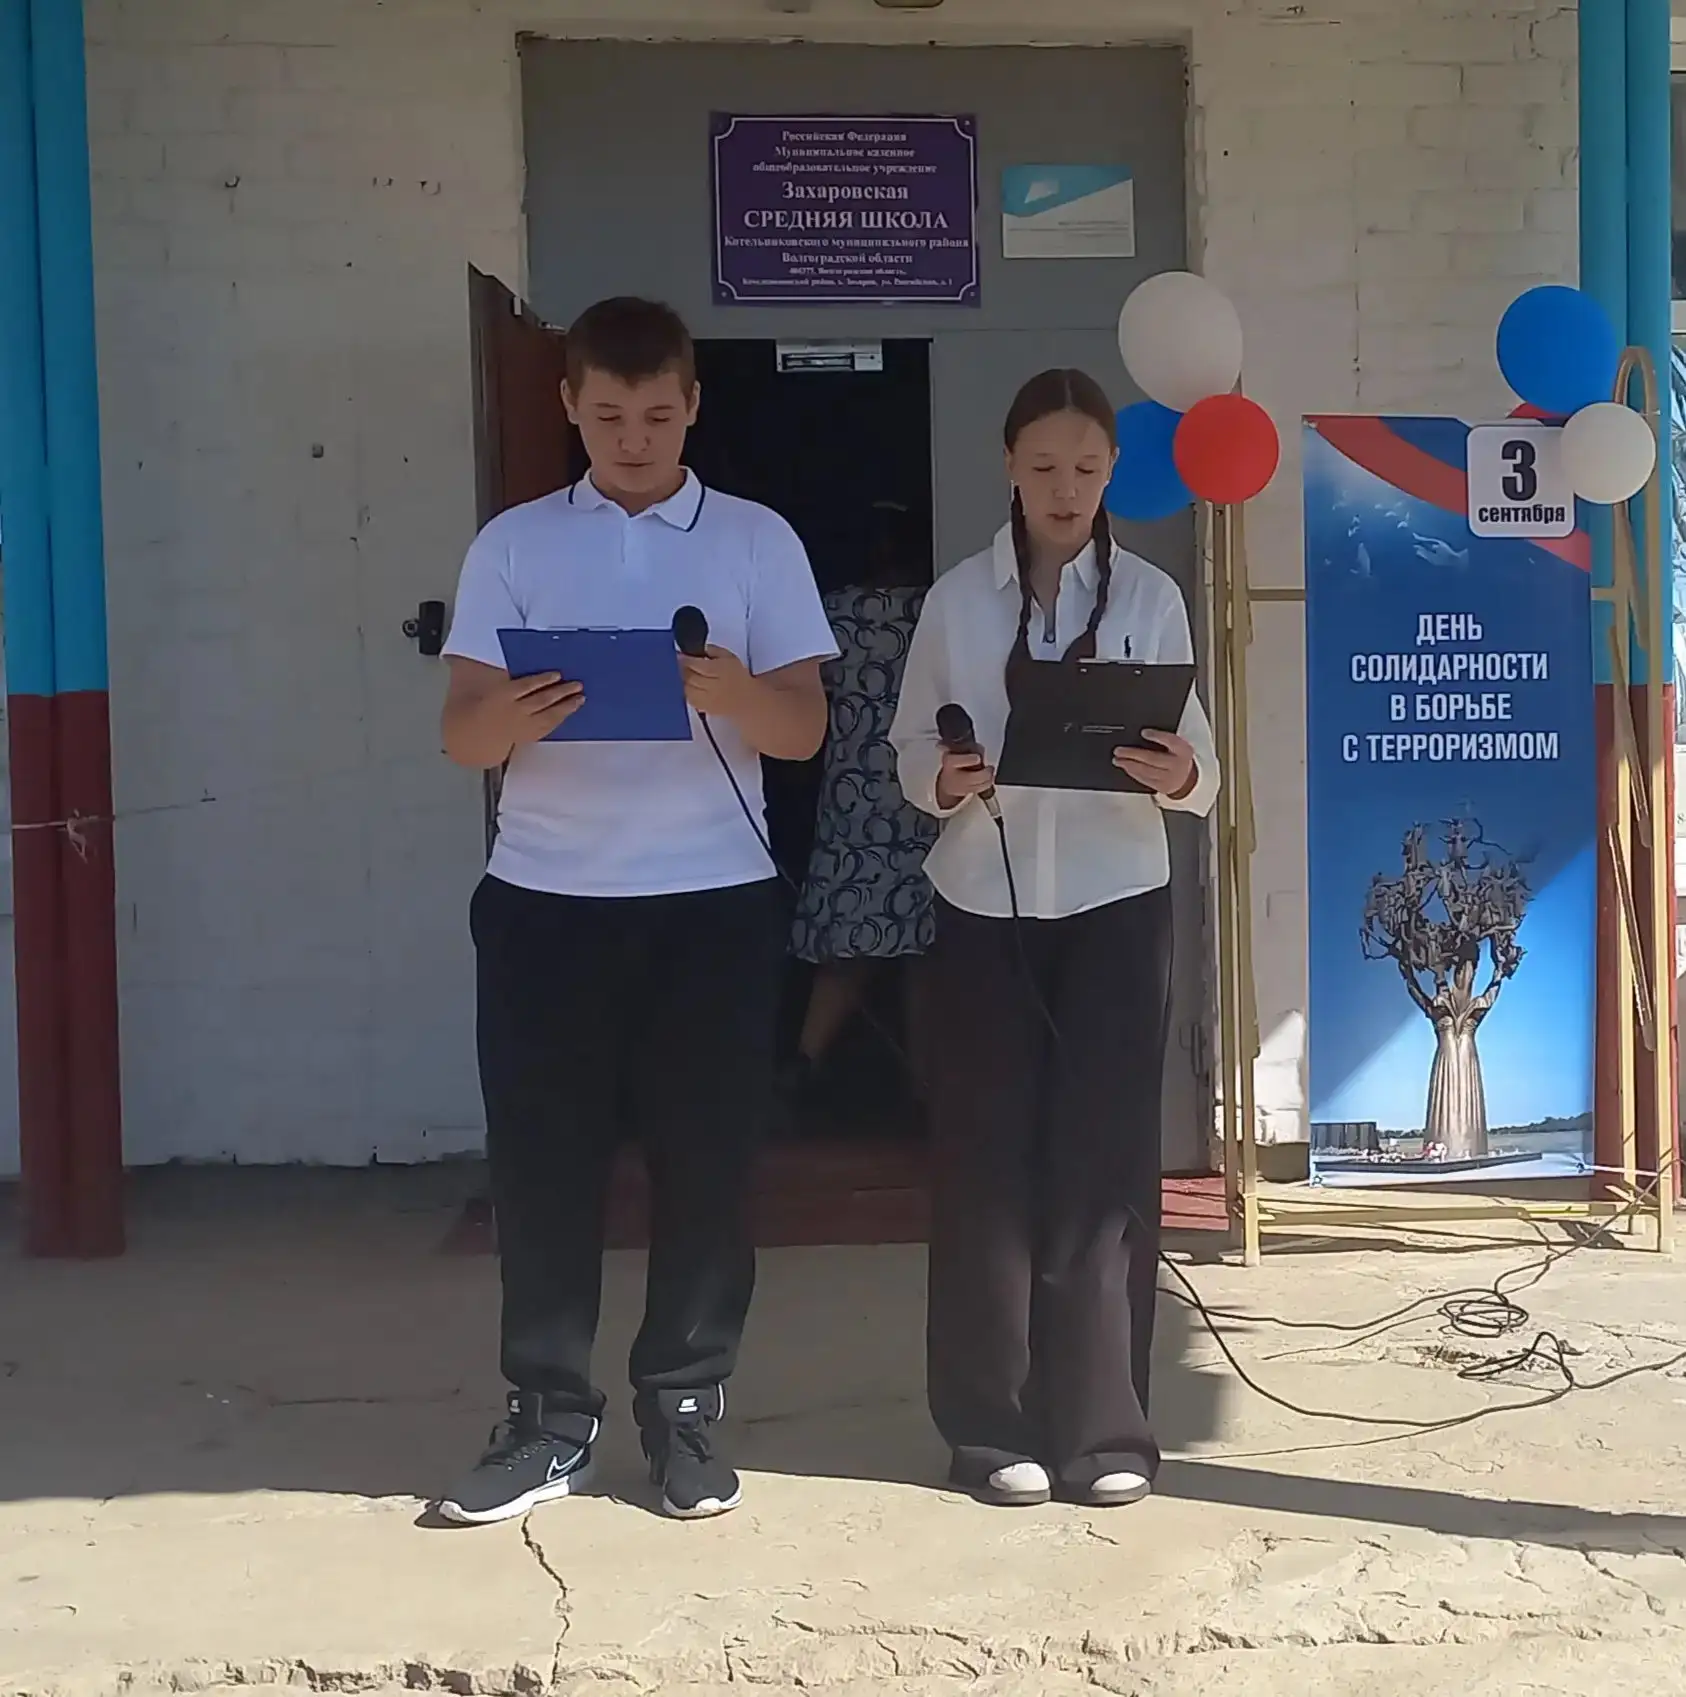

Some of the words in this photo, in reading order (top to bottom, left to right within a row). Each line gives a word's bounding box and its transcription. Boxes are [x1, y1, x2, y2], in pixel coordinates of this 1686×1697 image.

[782, 130, 844, 142] Российская
[847, 131, 907, 143] Федерация
[775, 145, 864, 158] Муниципальное
[867, 149, 915, 157] казенное
[752, 161, 870, 174] общеобразовательное
[872, 164, 937, 175] учреждение
[782, 180, 909, 203] Захаровская
[743, 210, 853, 232] СРЕДНЯЯ
[861, 211, 949, 229] ШКОЛА
[724, 235, 829, 247] Котельниковского
[831, 239, 926, 249] муниципального
[929, 237, 969, 250] района
[782, 252, 866, 265] Волгоградской
[868, 253, 913, 263] области
[1501, 439, 1538, 502] 3
[1478, 503, 1565, 525] сентября
[1416, 613, 1483, 646] ДЕНЬ
[1351, 652, 1548, 686] СОЛИДАРНОСТИ
[1390, 693, 1406, 721] В
[1415, 693, 1512, 721] БОРЬБЕ
[1342, 733, 1359, 762] С
[1366, 732, 1559, 762] ТЕРРОРИЗМОМ
